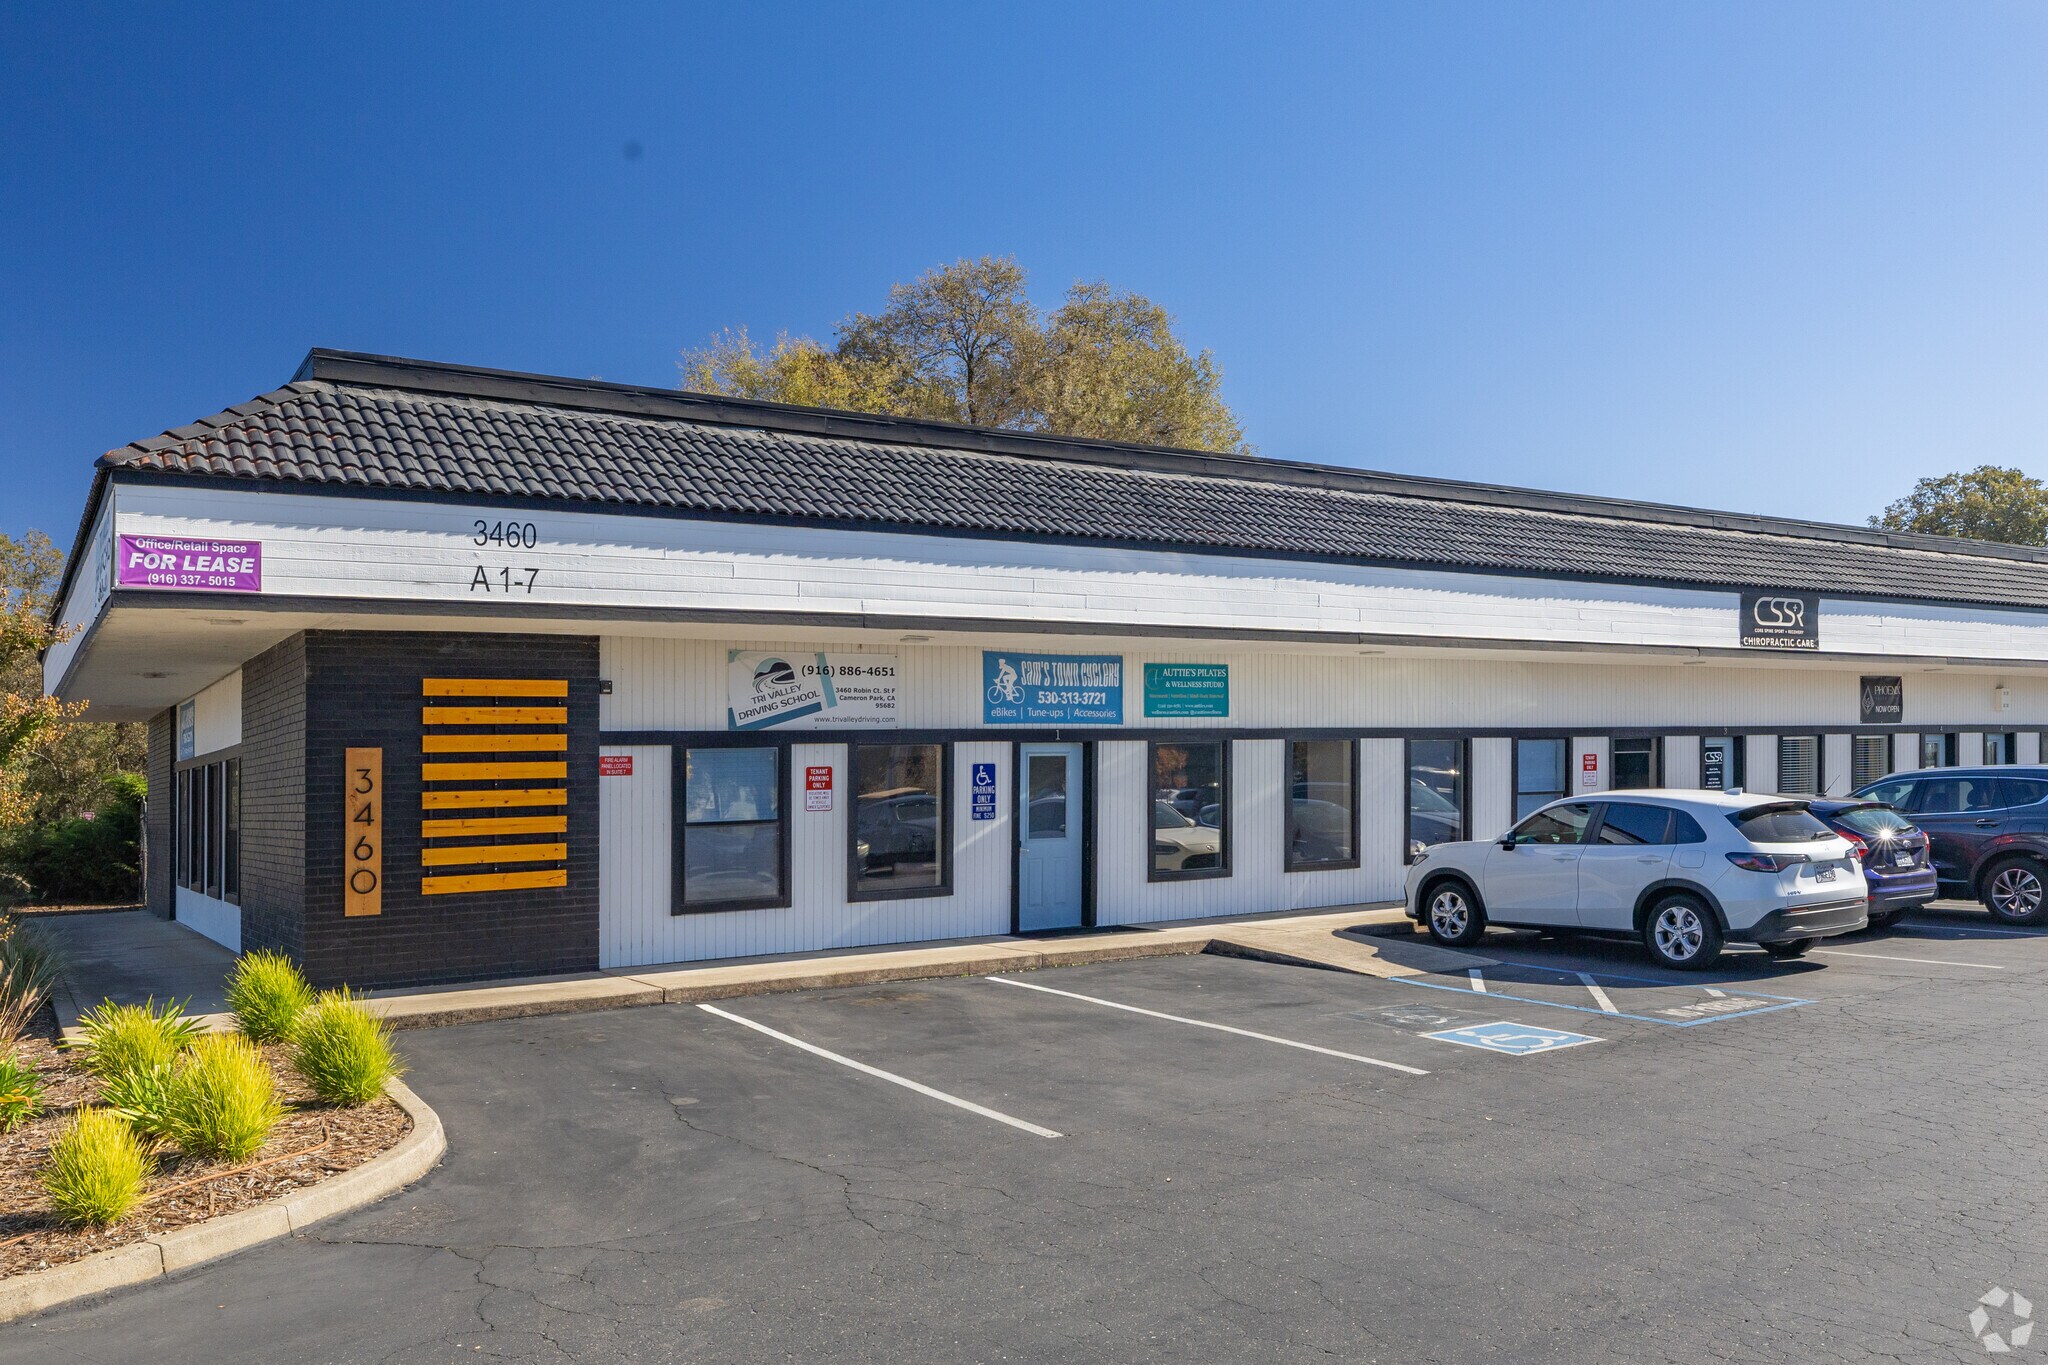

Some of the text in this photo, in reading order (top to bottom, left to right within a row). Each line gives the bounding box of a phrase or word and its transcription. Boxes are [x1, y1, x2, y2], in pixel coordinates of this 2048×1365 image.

[474, 519, 537, 549] 3460
[135, 538, 247, 554] Office/Retail Space
[128, 552, 255, 573] FOR LEASE
[147, 573, 177, 586] (916)
[208, 576, 236, 586] 5015
[470, 565, 540, 594] A 1-7
[1754, 596, 1804, 627] CSSR
[1743, 636, 1815, 648] CHIROPRACTIC CARE
[801, 665, 896, 678] (916) 886-4651
[1162, 668, 1226, 678] AUTTIE'S PILATES
[751, 684, 802, 704] TRI VALLEY
[1038, 691, 1106, 704] 530-313-3721
[738, 690, 820, 720] DRIVING SCHOOL
[991, 707, 1117, 718] eBikes Tune-ups Accessories
[814, 716, 896, 724] www.trivalleydriving.com
[1056, 730, 1060, 740] 1
[1724, 728, 1728, 736] 3
[973, 786, 995, 794] PARKING
[976, 795, 992, 804] ONLY
[350, 768, 378, 895] 3460
